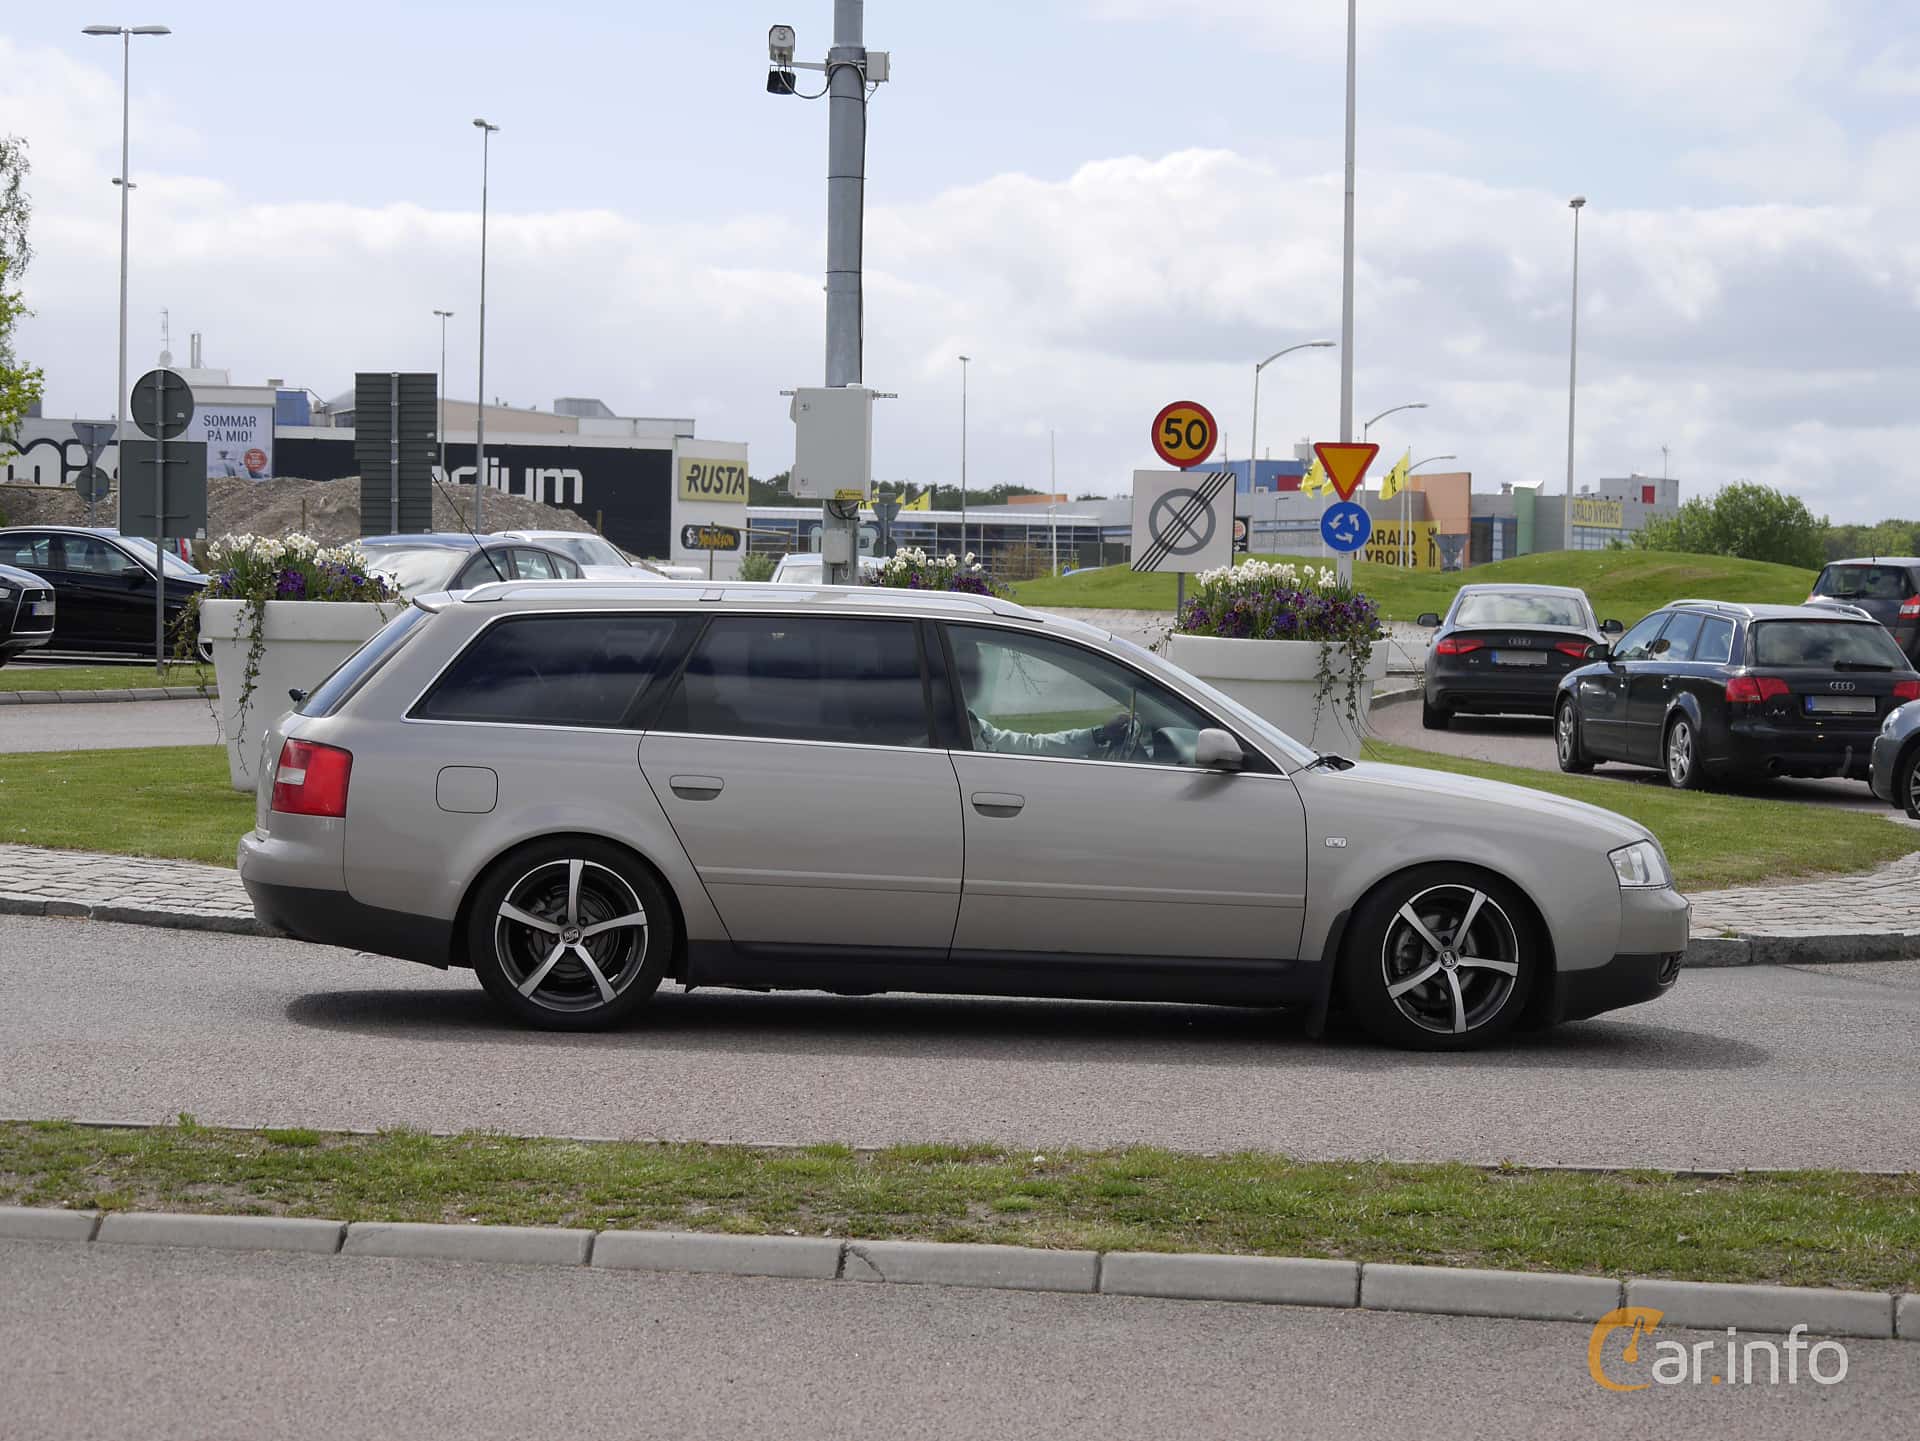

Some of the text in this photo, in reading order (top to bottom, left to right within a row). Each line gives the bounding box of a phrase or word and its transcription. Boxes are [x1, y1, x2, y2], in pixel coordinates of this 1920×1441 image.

[203, 415, 257, 428] SOMMAR
[207, 428, 252, 442] PÅ MIO!
[1164, 418, 1208, 450] 50
[686, 464, 745, 495] RUSTA
[1367, 529, 1417, 546] ARALD
